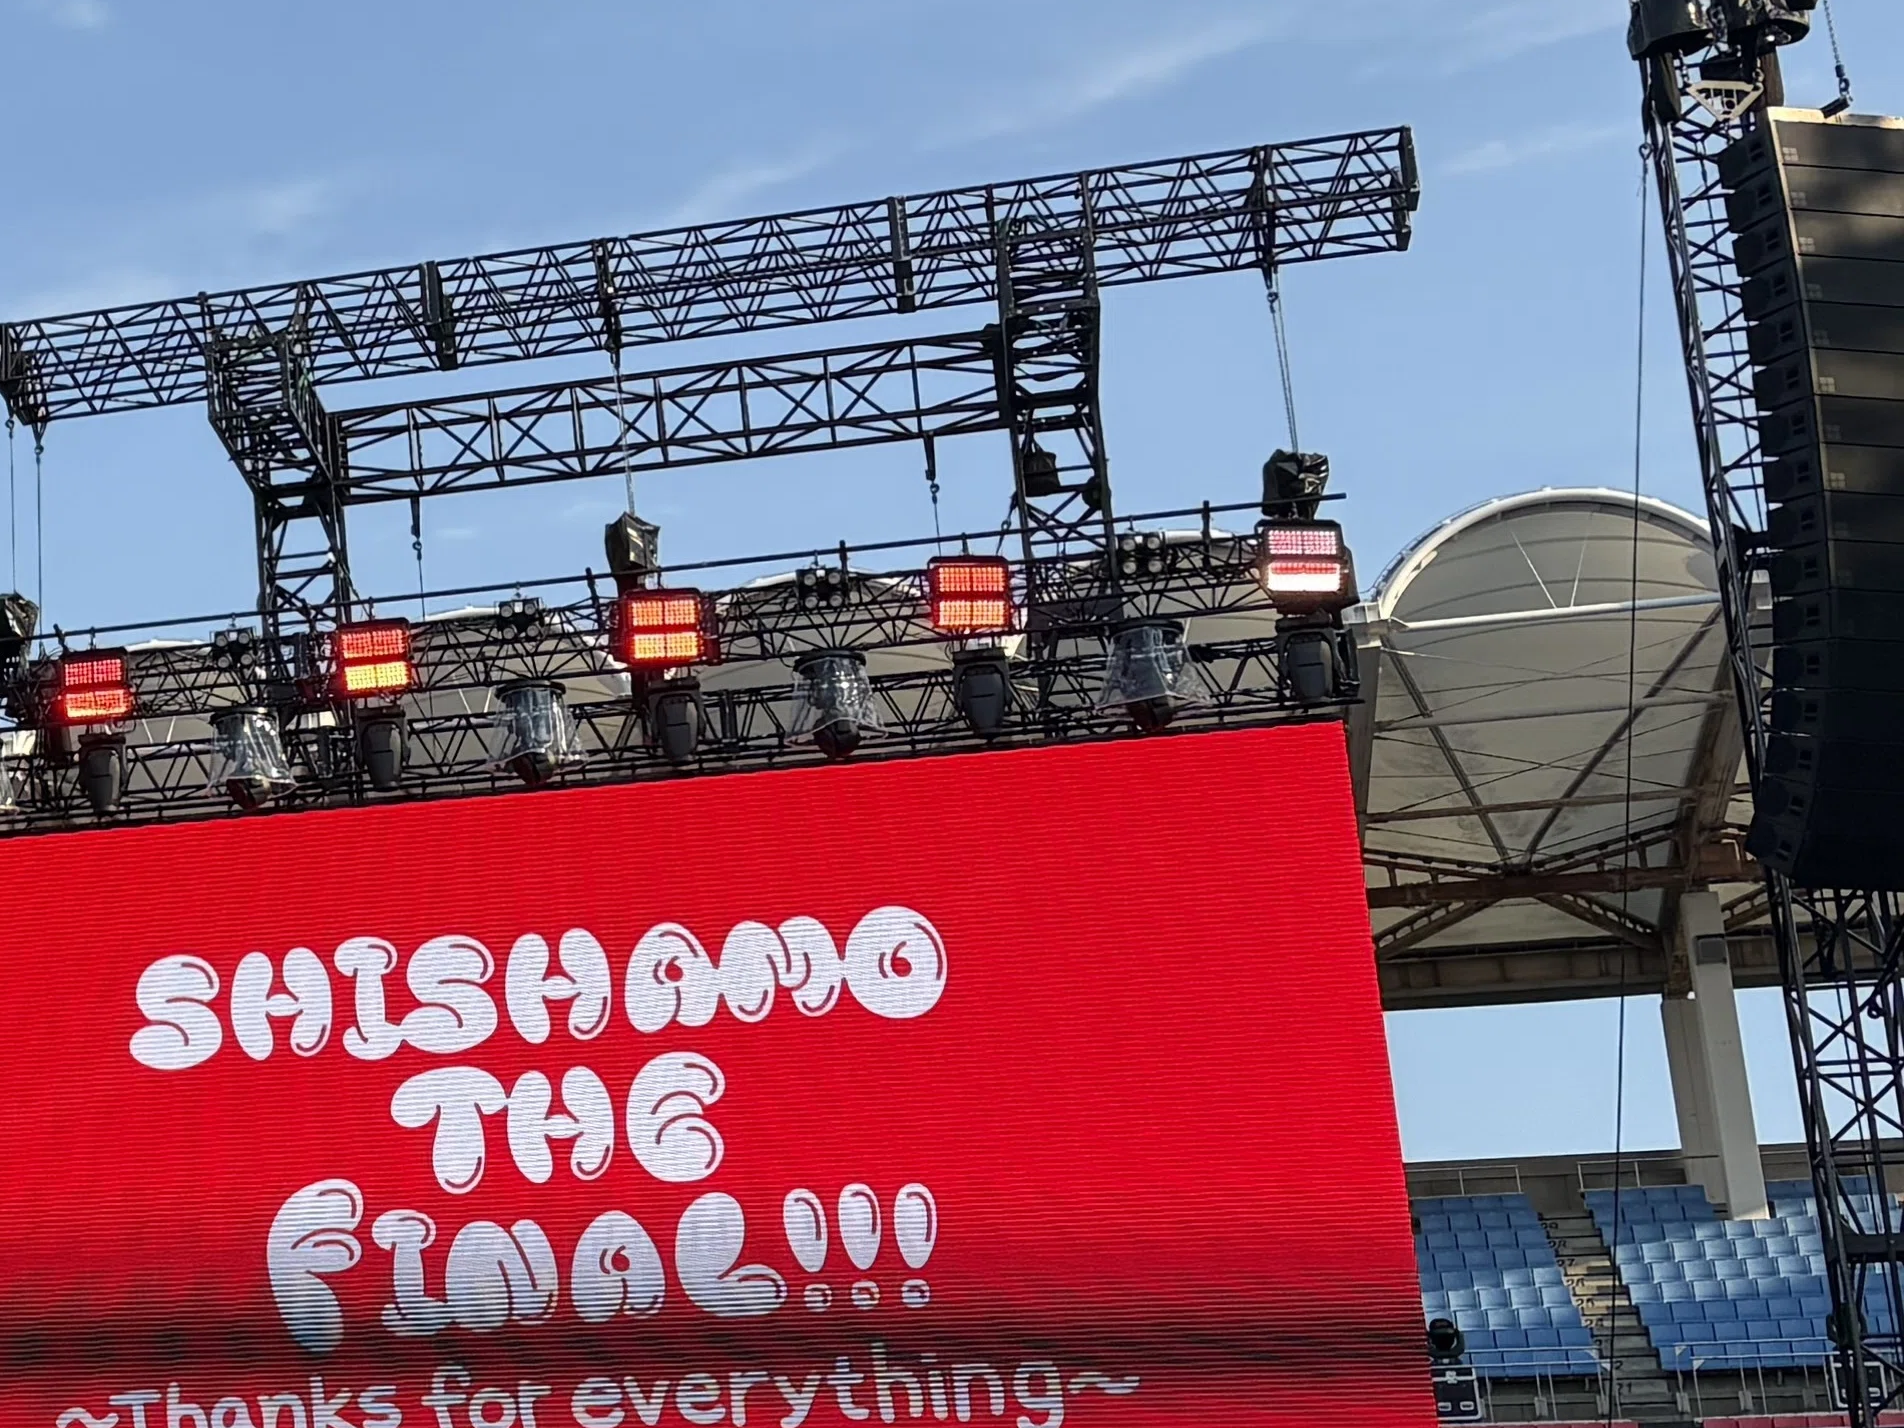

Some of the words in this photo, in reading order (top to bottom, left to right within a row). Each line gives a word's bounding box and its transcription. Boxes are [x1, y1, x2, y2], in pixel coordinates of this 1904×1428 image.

[128, 906, 949, 1071] SHISHAMO
[390, 1052, 726, 1195] THE
[267, 1179, 938, 1352] FINAL!!!
[1557, 1258, 1575, 1268] 27
